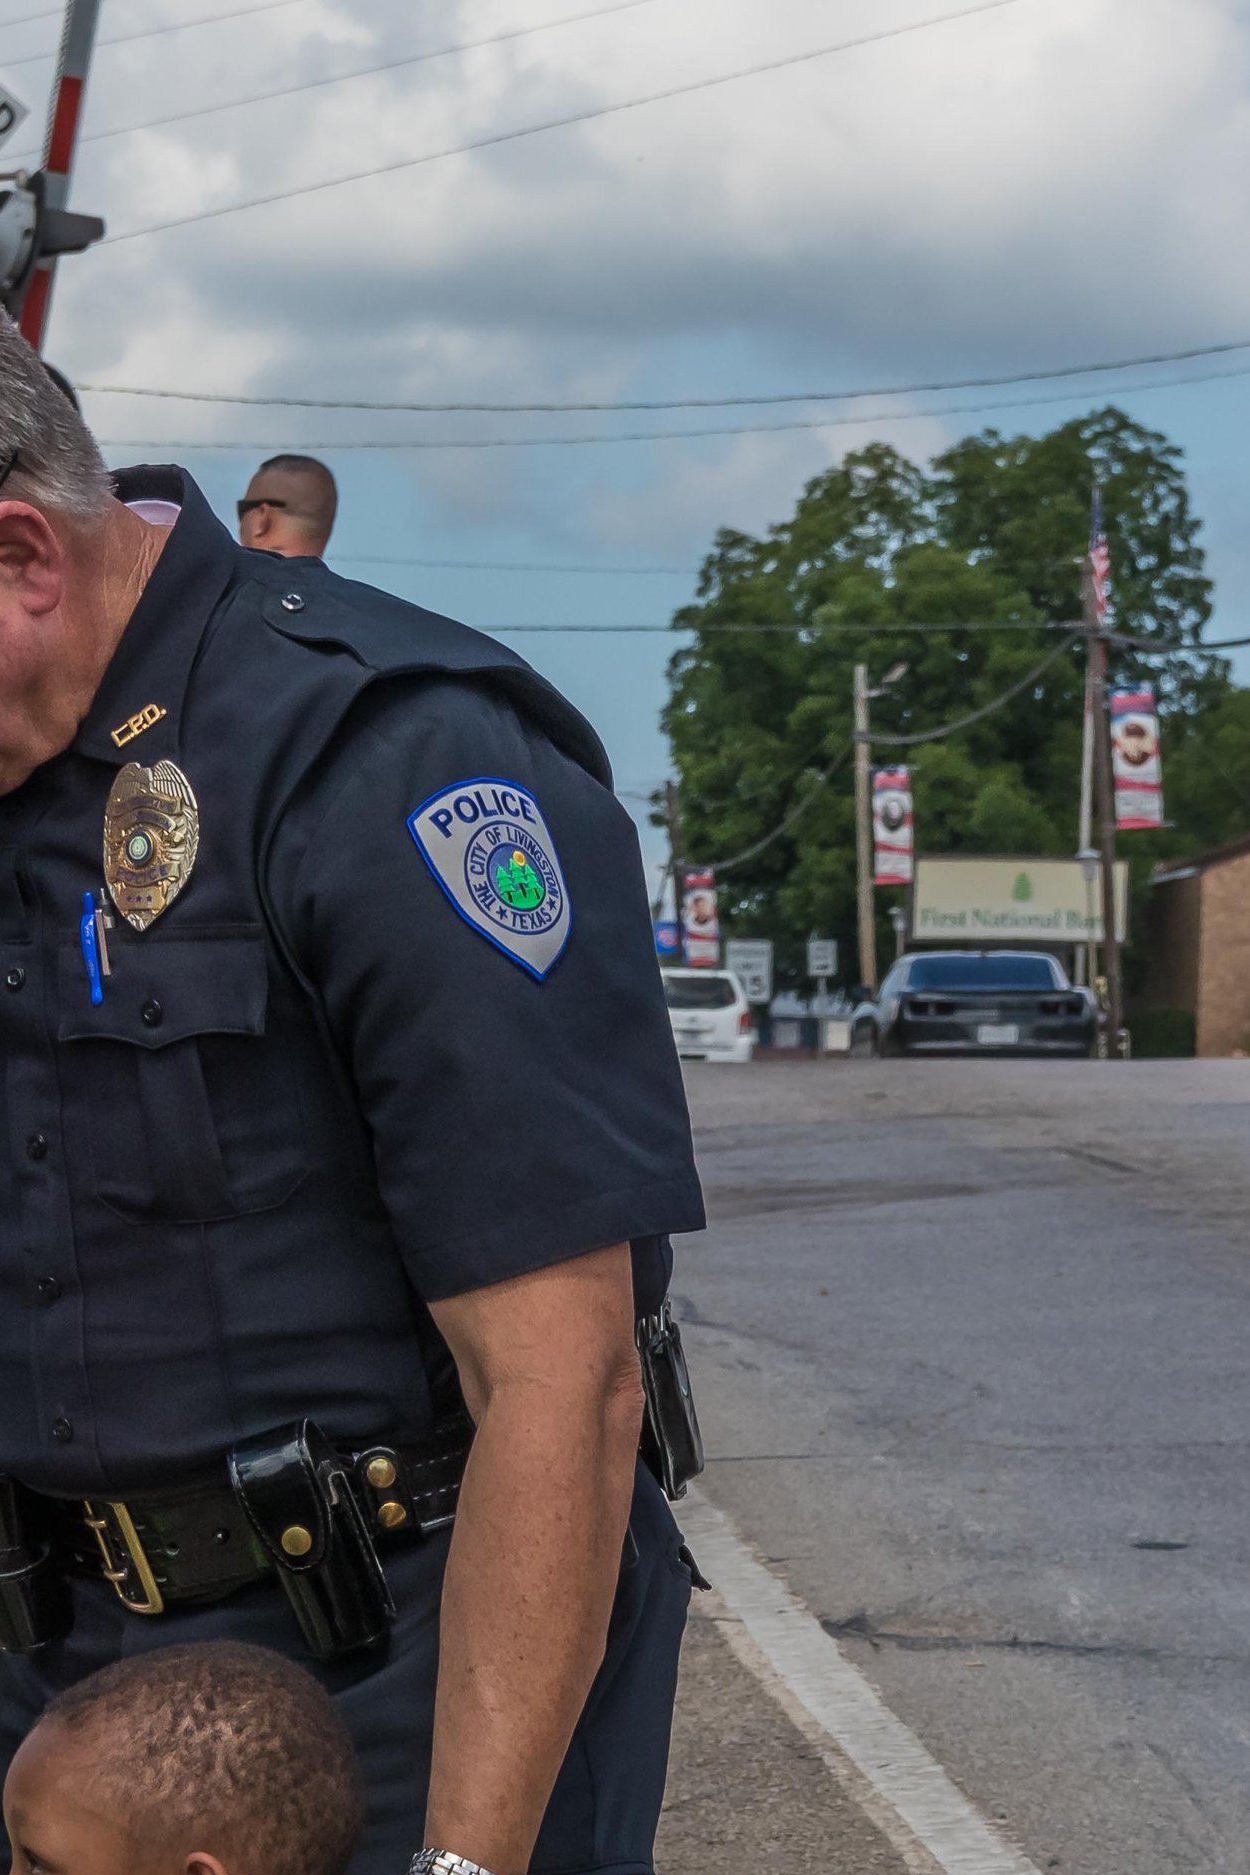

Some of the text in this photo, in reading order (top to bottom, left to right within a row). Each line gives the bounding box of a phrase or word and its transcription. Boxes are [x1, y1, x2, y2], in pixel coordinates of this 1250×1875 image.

[428, 789, 537, 839] POLICE
[116, 863, 168, 884] POLICE
[470, 826, 559, 911] THE CITY OF LIVINGSTON
[511, 907, 552, 930] TEXAS
[920, 907, 966, 927] First
[971, 907, 1062, 929] National
